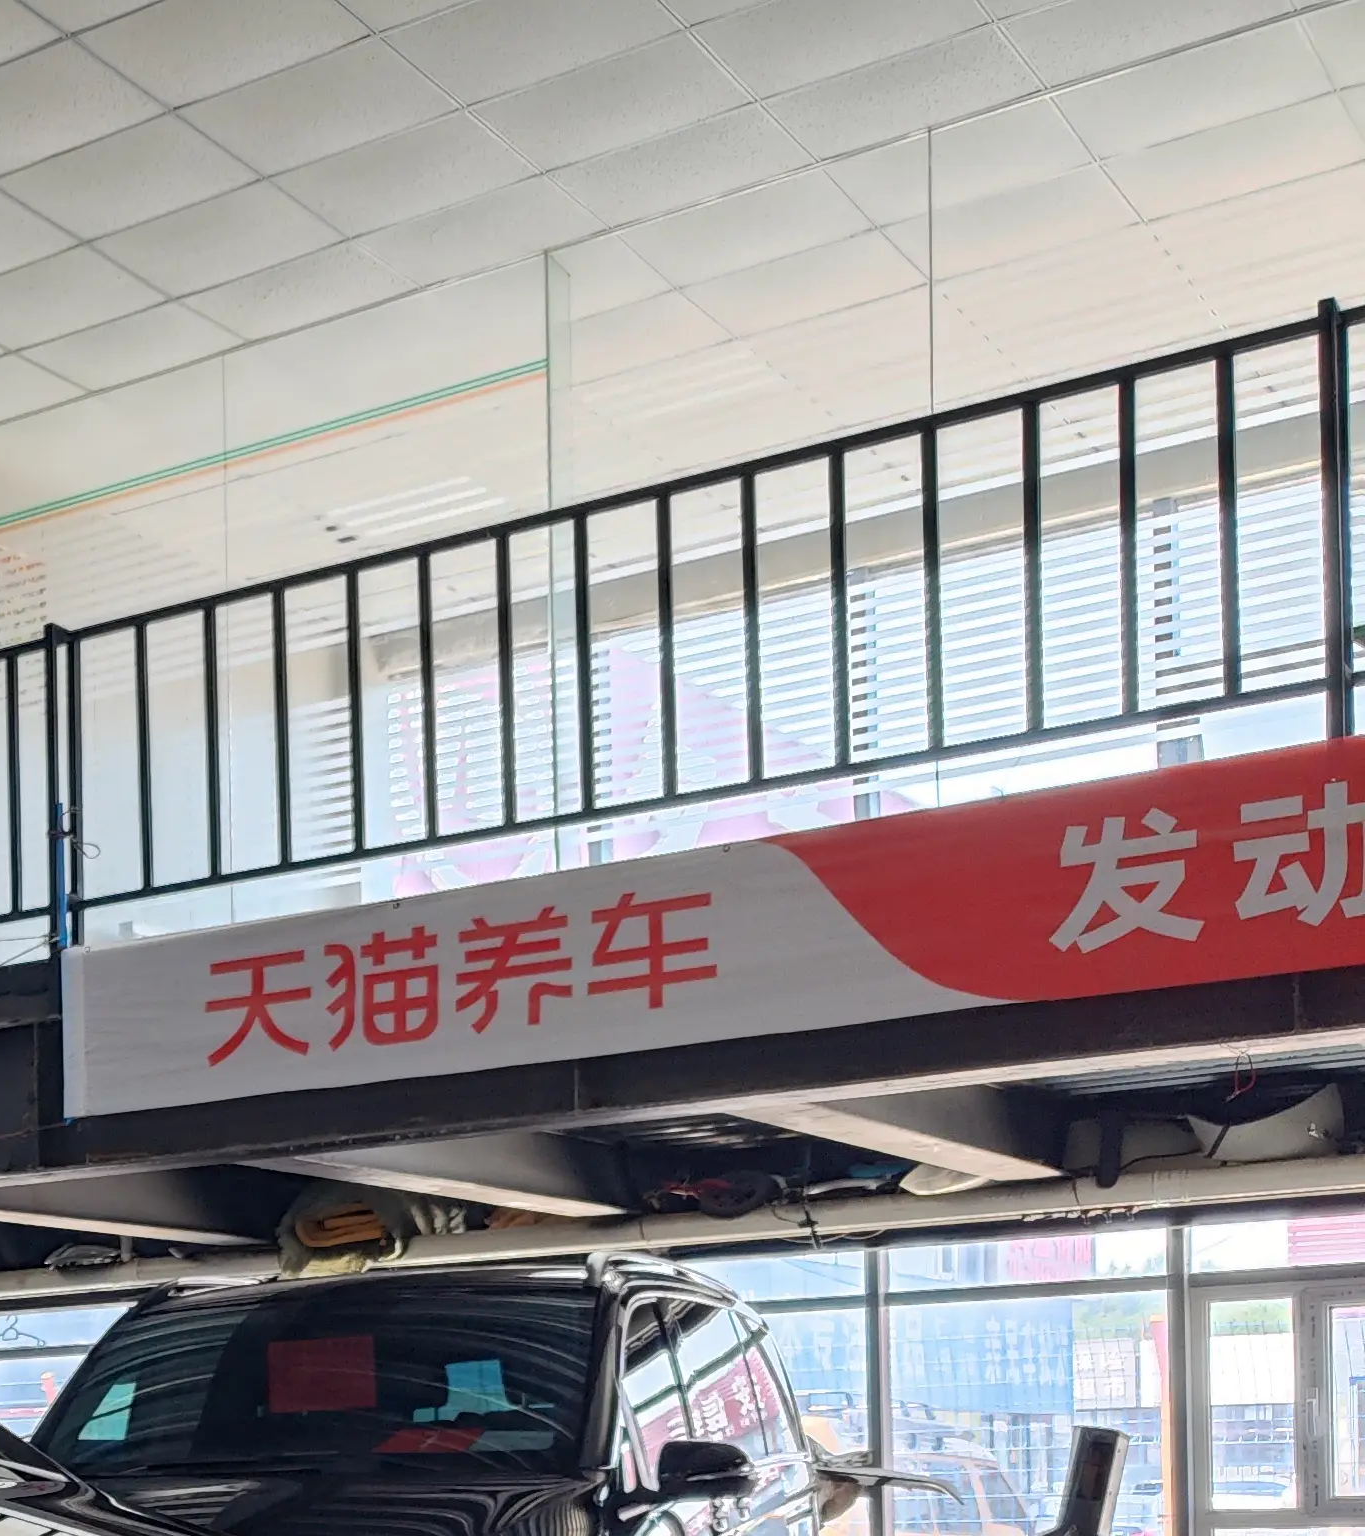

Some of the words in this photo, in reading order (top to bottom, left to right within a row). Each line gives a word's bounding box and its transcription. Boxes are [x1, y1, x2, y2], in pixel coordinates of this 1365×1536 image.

[1048, 779, 1365, 954] 发动
[203, 890, 720, 1068] 天猫养车
